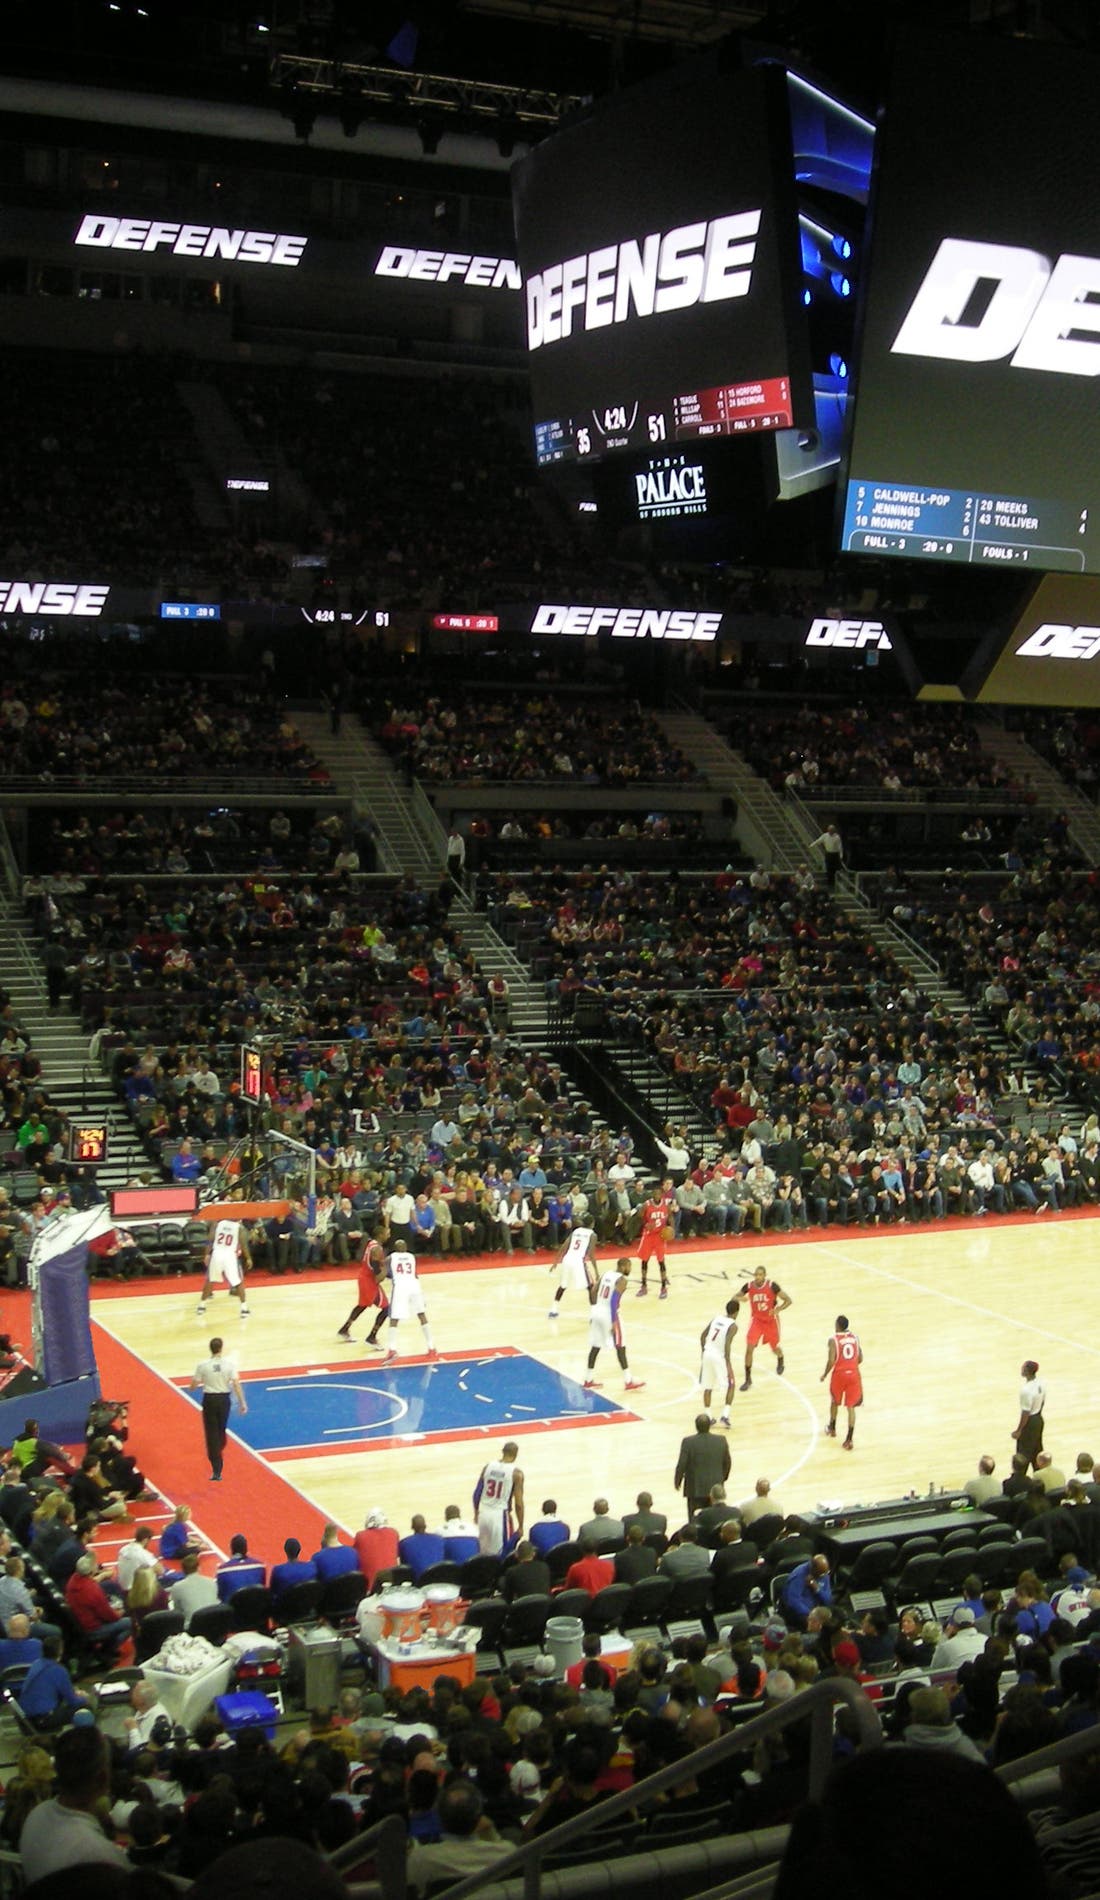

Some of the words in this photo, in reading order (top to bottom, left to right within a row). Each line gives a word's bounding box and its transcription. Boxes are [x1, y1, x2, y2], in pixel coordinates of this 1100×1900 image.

[75, 214, 308, 266] DEFENSE
[526, 209, 762, 351] DEFENSE
[647, 414, 667, 442] 51
[577, 428, 591, 454] 35
[635, 466, 706, 504] PALACE
[858, 486, 866, 499] 5
[873, 488, 951, 507] CALDWELL-POP
[965, 497, 973, 509] 2
[856, 500, 864, 512] 7
[872, 502, 921, 518] JENNINGS
[963, 511, 971, 523] 2
[980, 500, 993, 511] 20
[995, 501, 1028, 515] MEEKS
[1080, 509, 1088, 521] 4
[855, 515, 868, 527] 10
[870, 516, 915, 532] MONROE
[962, 525, 970, 537] 6
[979, 513, 991, 525] 43
[994, 515, 1039, 530] TOLLIVER
[863, 535, 889, 548] FULL
[898, 538, 906, 550] 3
[982, 546, 1013, 560] FOULS
[1022, 550, 1029, 561] 1
[531, 604, 723, 641] DEFENSE
[217, 1232, 233, 1246] 20
[573, 1239, 581, 1250] 5
[396, 1262, 412, 1274] 43
[711, 1327, 720, 1342] 7
[842, 1343, 855, 1360] 0
[486, 1479, 503, 1499] 31
